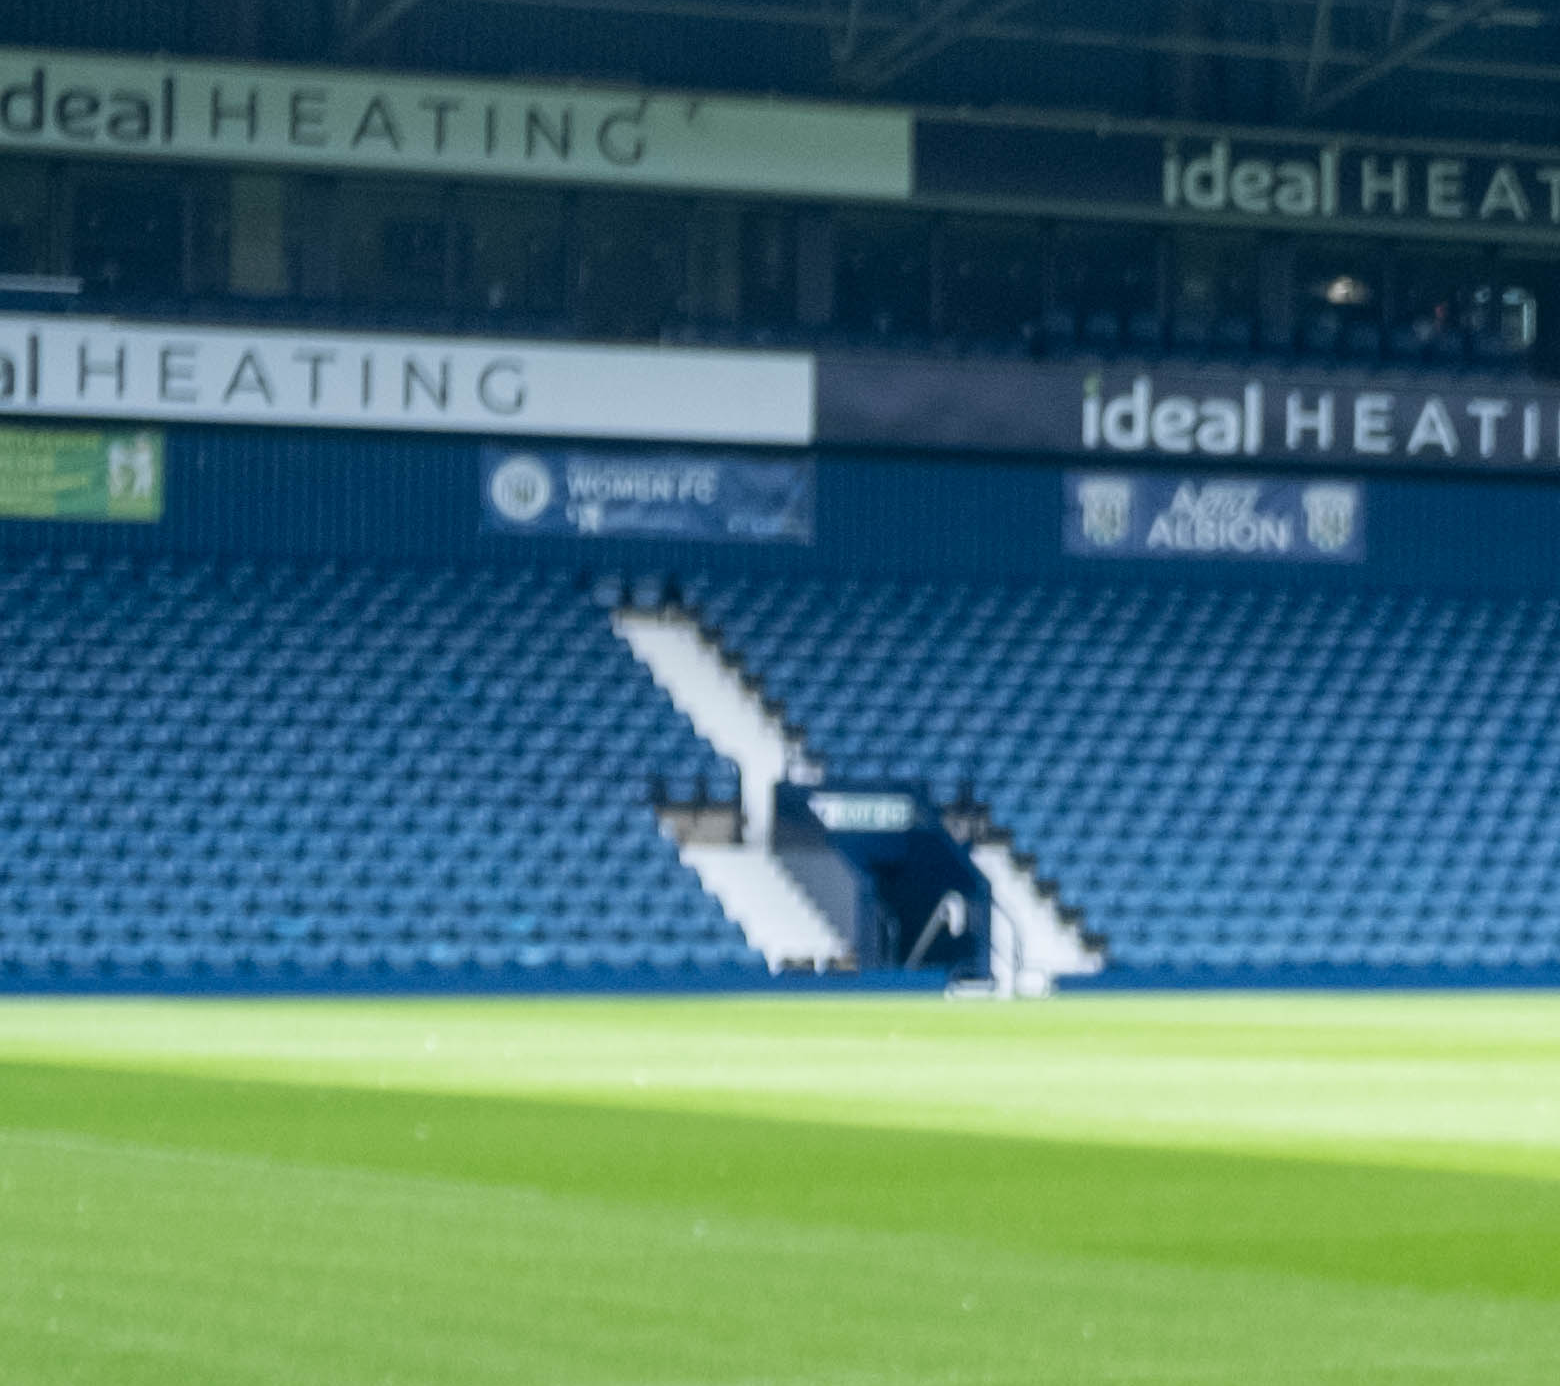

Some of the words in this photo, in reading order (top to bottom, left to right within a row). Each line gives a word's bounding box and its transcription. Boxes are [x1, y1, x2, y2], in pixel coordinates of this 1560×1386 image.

[1, 68, 174, 144] deal
[210, 85, 648, 167] HEATING
[1163, 137, 1337, 215] ideal
[78, 339, 528, 415] HEATING
[1082, 373, 1263, 456] ideal
[1146, 511, 1293, 554] ALBION
